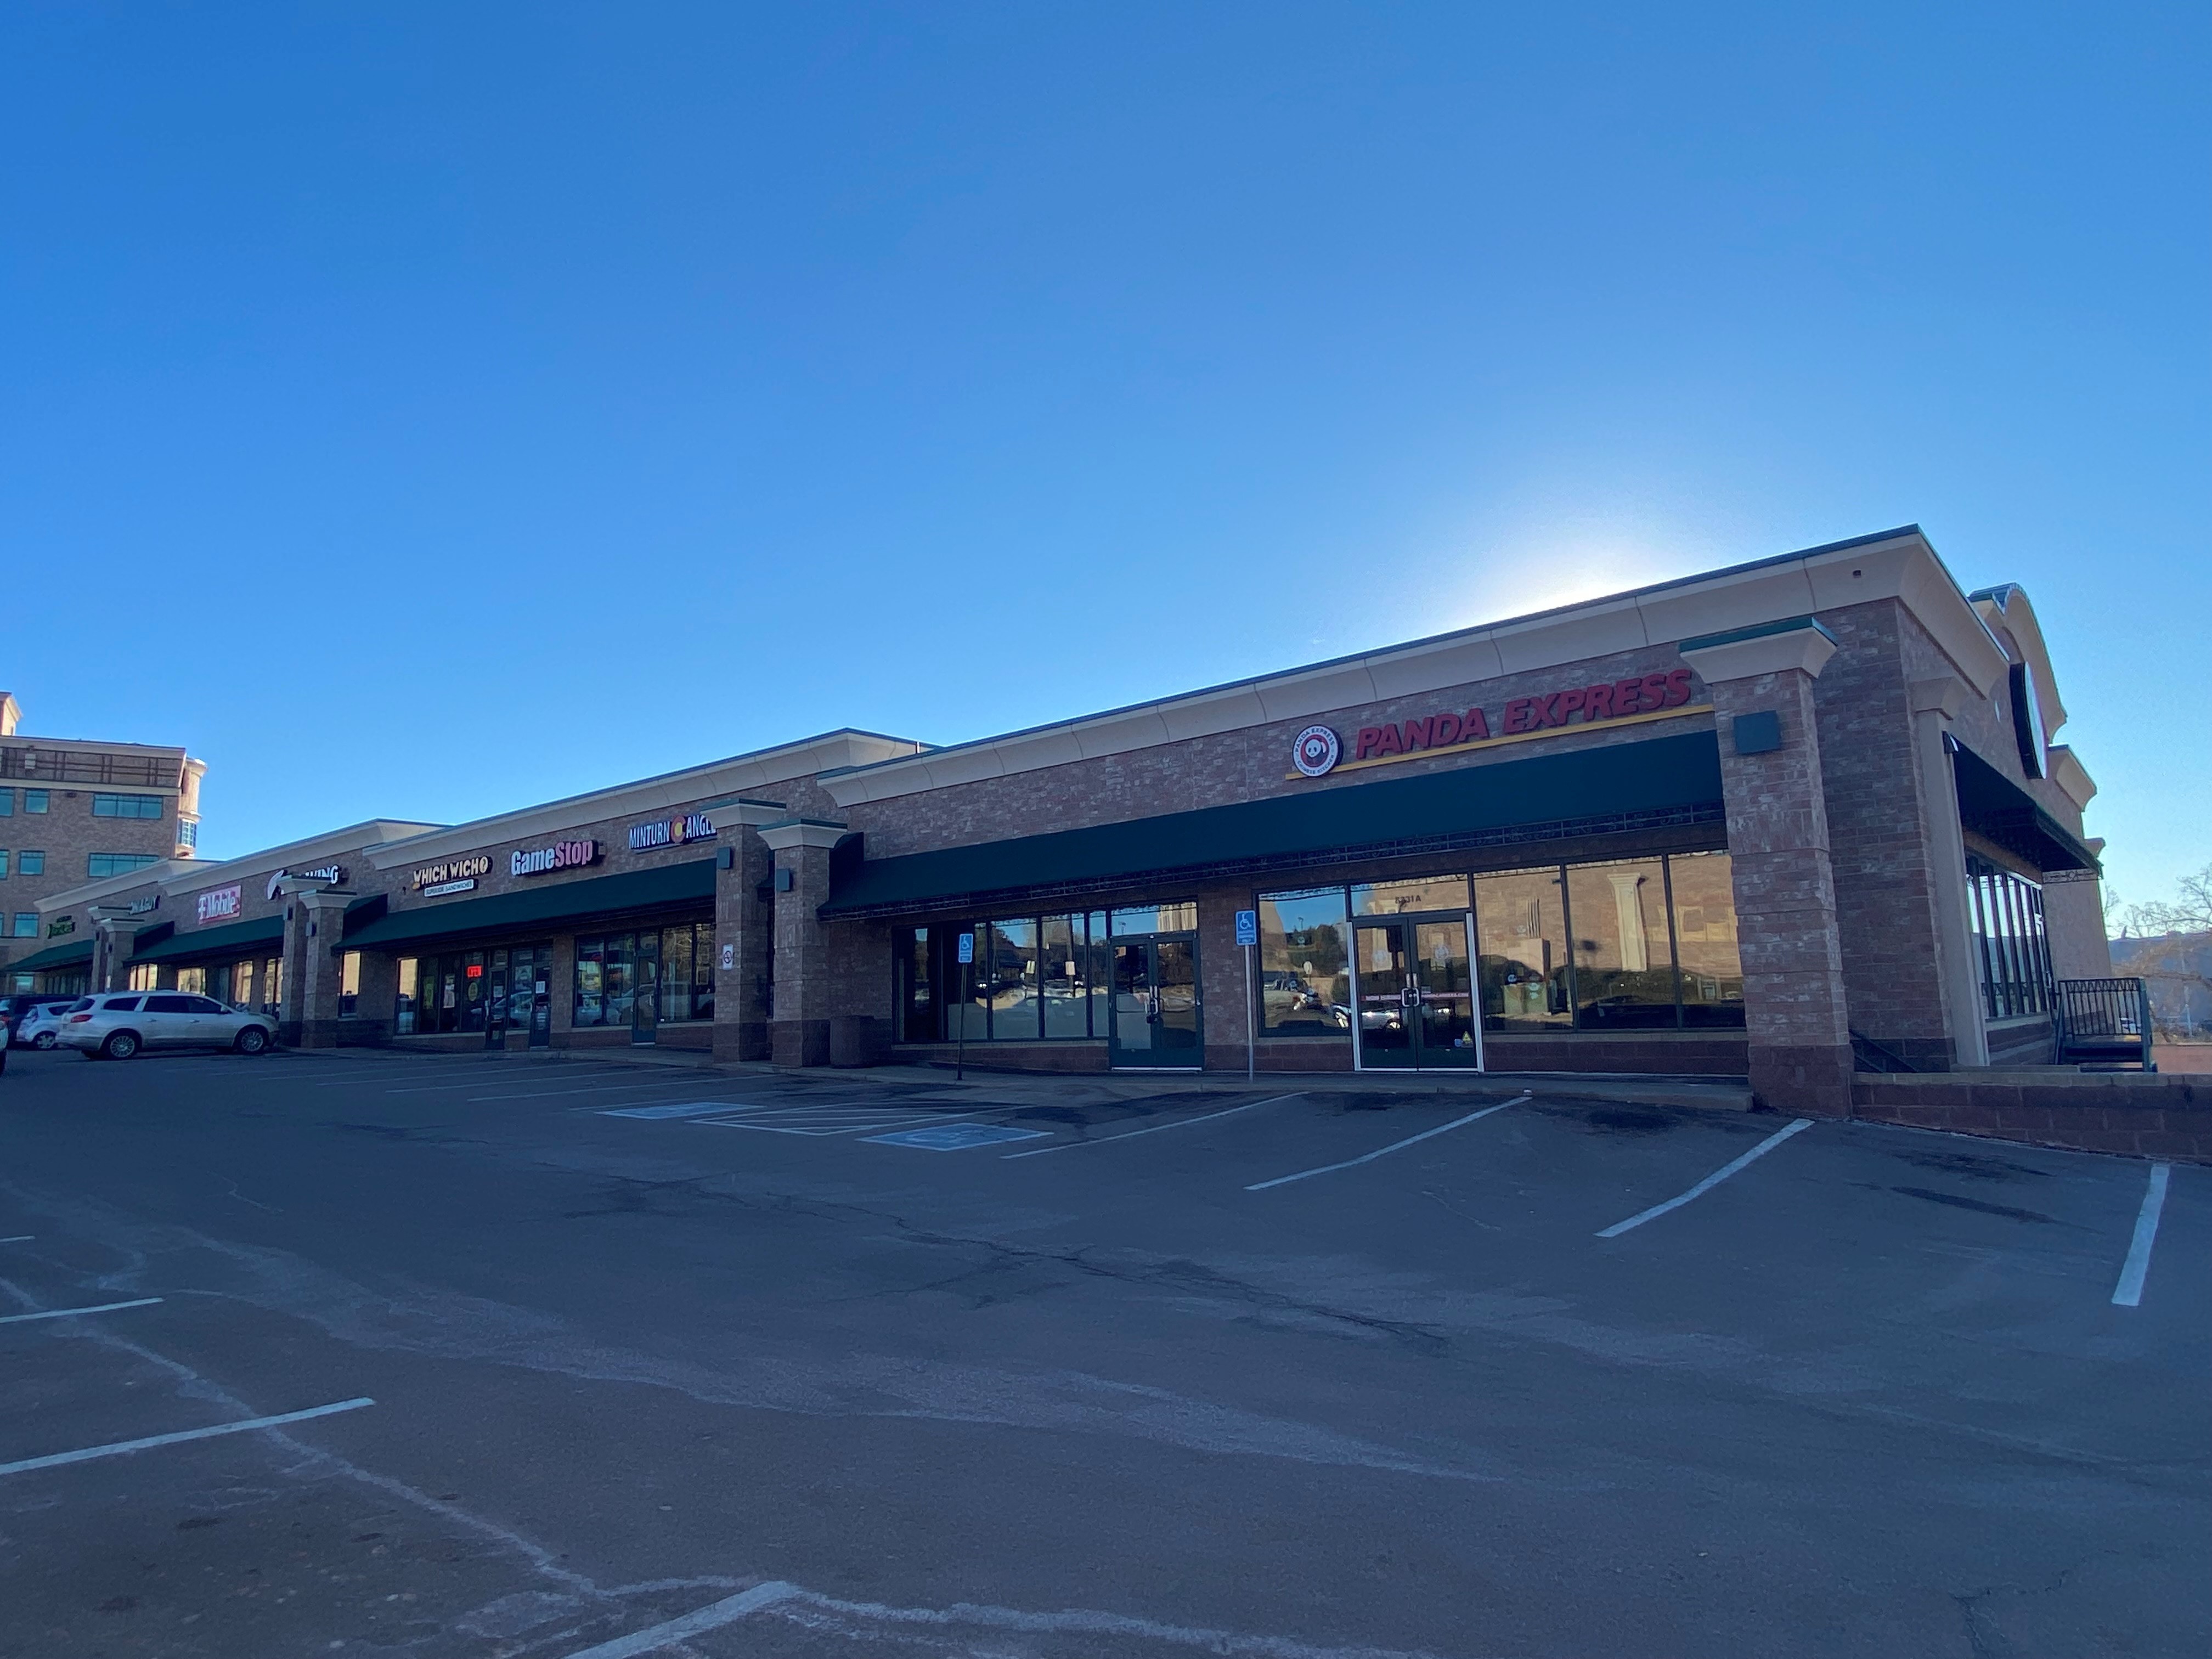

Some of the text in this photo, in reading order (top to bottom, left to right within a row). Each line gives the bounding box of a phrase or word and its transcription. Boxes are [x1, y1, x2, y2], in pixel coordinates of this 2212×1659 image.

[1356, 668, 1692, 760] PANDA EXPRESS
[1295, 731, 1310, 753] PANDA
[629, 820, 670, 849] MINTURN
[511, 840, 593, 876] GameStop
[413, 864, 448, 885] WHICH
